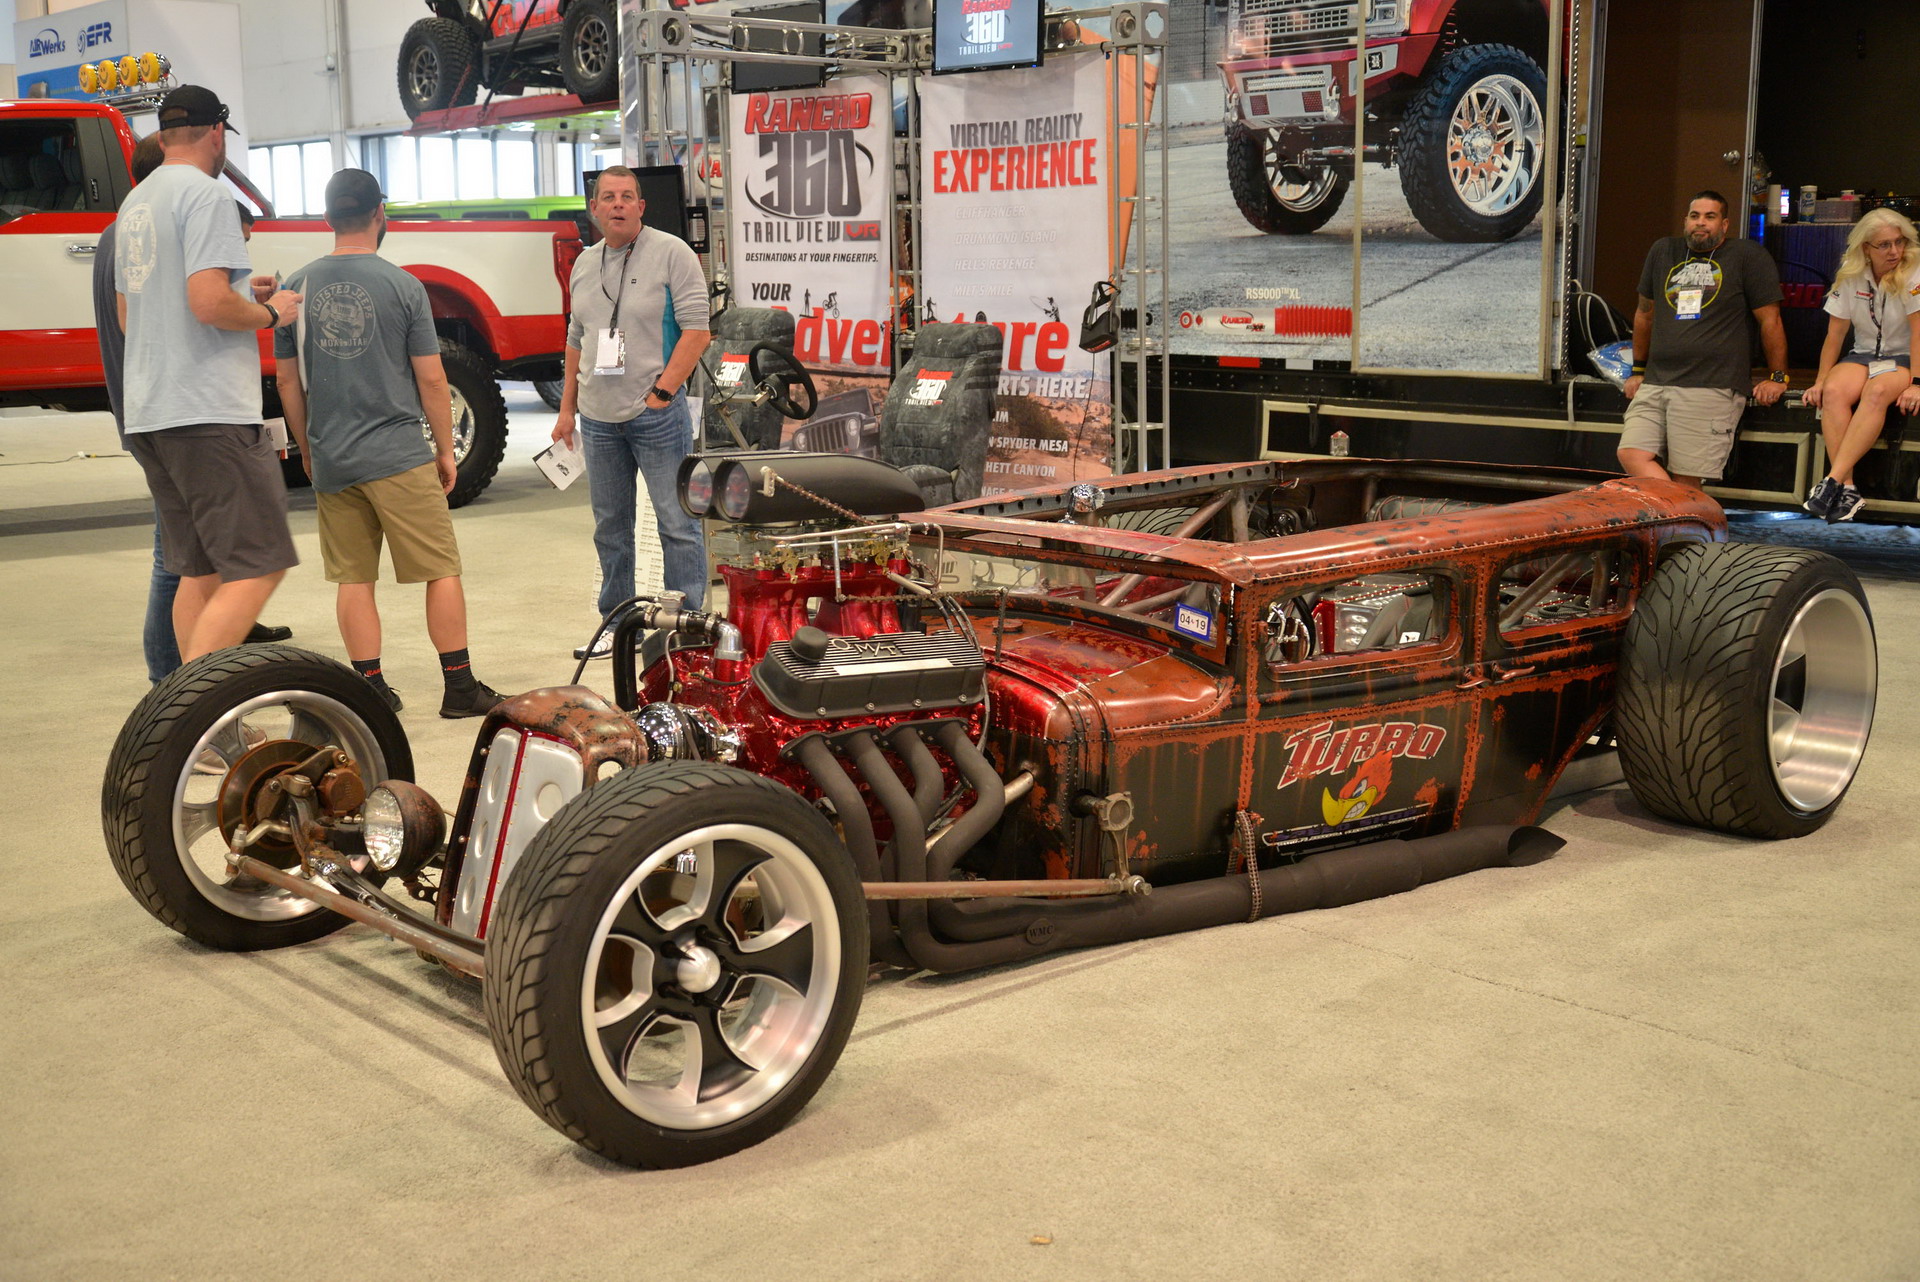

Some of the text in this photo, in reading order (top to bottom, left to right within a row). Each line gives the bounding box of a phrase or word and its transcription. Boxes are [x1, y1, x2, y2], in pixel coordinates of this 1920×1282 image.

[86, 21, 113, 47] EFR
[966, 10, 1005, 44] 360
[745, 92, 872, 134] RANCHO
[950, 112, 1083, 148] VIRTUAL REALITY
[759, 130, 862, 217] 360
[933, 138, 1098, 194] EXPERIENCE
[956, 205, 1027, 219] CLIFFHANGER
[846, 223, 880, 238] VR
[955, 230, 1057, 245] DRUMMOND ISLAND
[745, 252, 879, 263] DESTINATIONS AT YOUR FINGERTIPS.
[954, 257, 1036, 271] HELL'S REVENGE
[311, 284, 351, 318] TWISTED
[751, 282, 792, 301] YOUR
[1035, 376, 1090, 399] HERE.
[996, 436, 1036, 450] SPYDER
[1039, 439, 1069, 452] MESA
[1013, 463, 1056, 477] CANYON
[1277, 720, 1447, 789] TURBO
[1028, 924, 1054, 939] WMC
